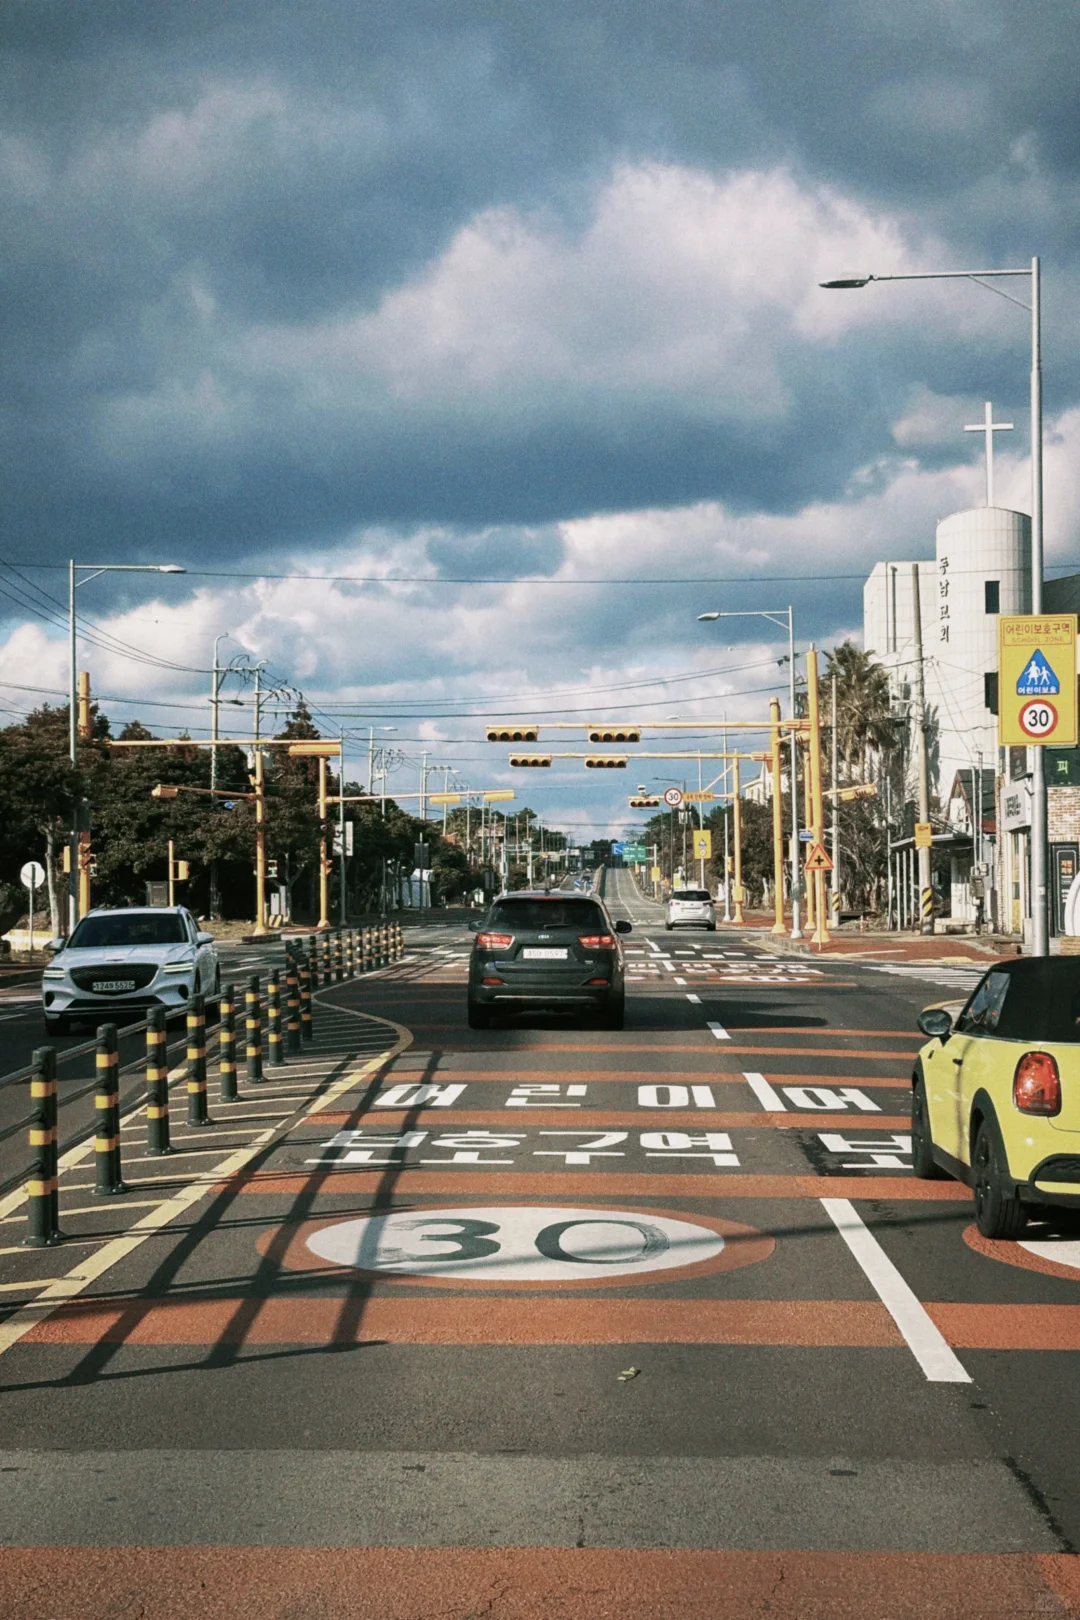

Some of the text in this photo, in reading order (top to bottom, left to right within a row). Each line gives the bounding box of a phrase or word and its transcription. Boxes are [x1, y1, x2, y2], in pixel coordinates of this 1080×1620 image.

[1006, 622, 1071, 636] 어린이보호구역
[1017, 685, 1058, 694] 어린이보호
[1028, 709, 1049, 727] 30
[668, 792, 679, 801] 30
[374, 1083, 716, 1107] 어린이
[304, 1130, 741, 1167] 보호구역
[376, 1218, 670, 1265] 30
